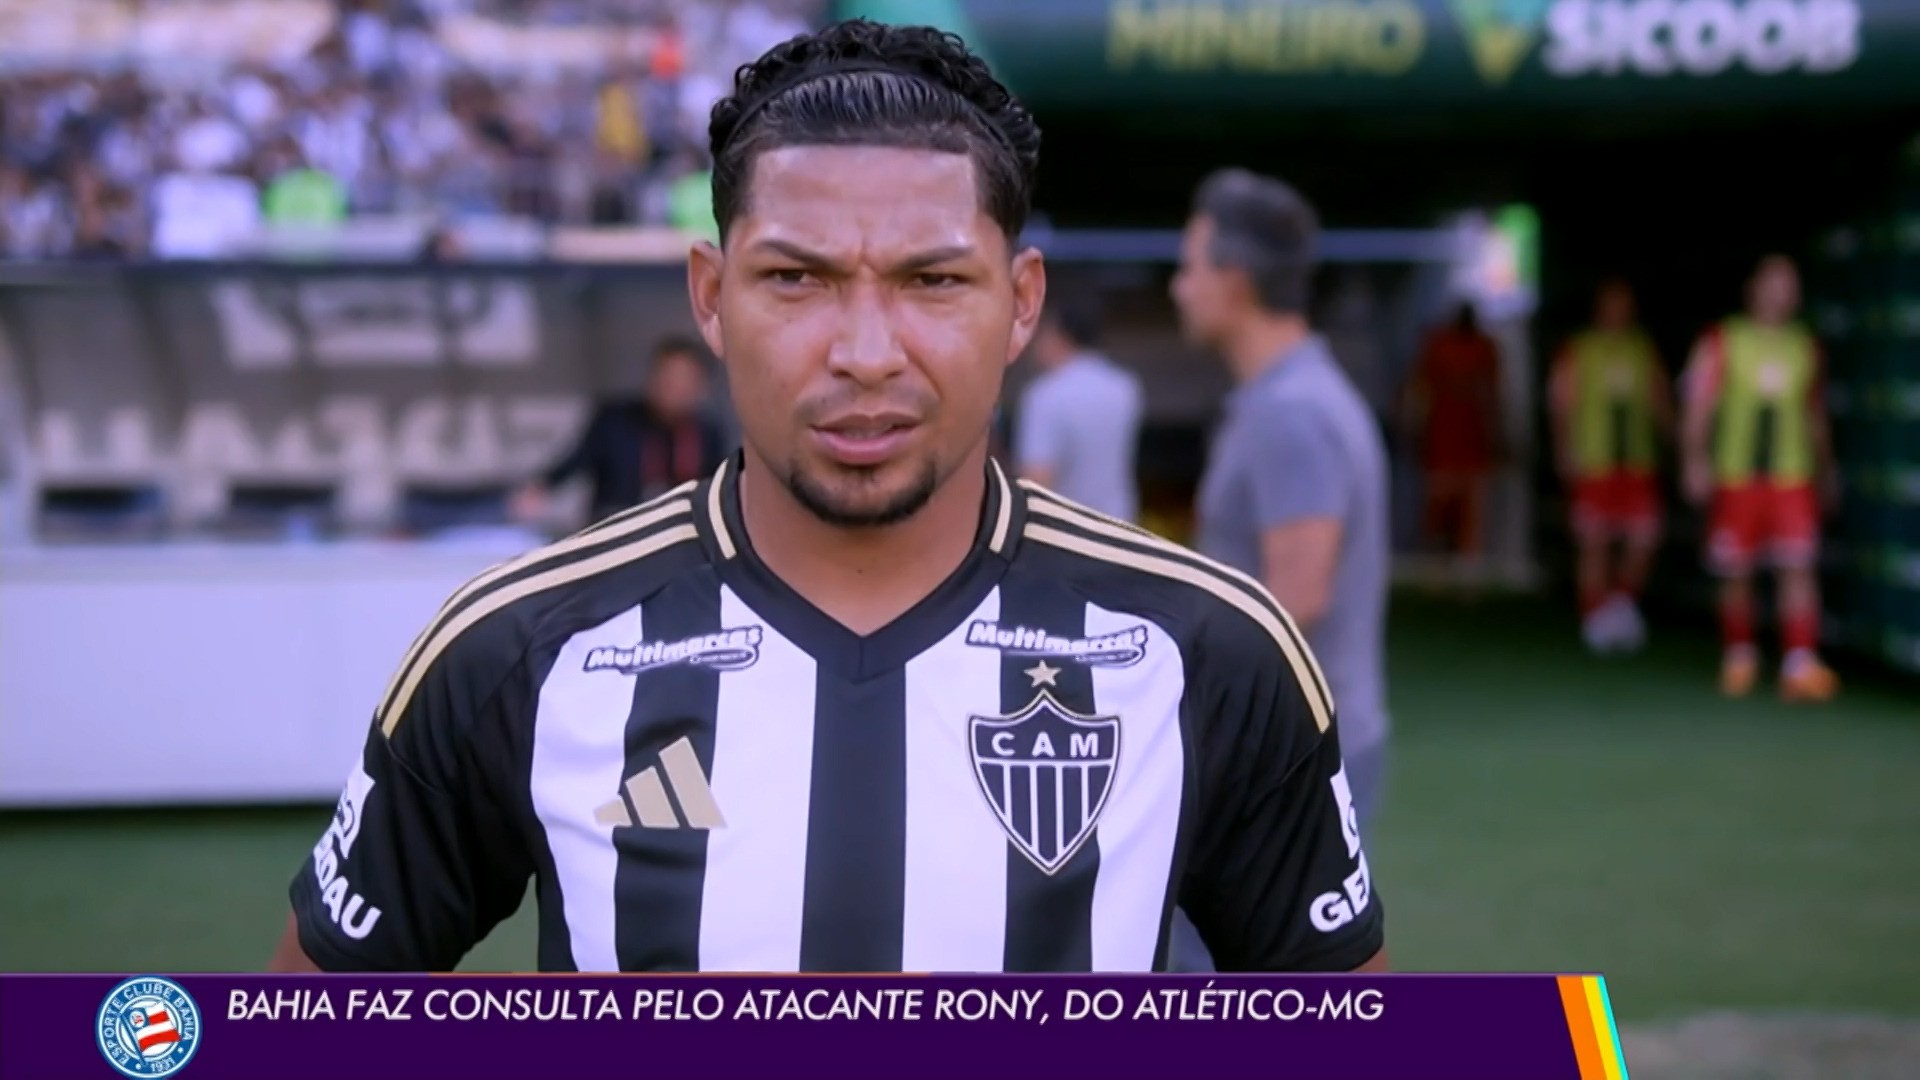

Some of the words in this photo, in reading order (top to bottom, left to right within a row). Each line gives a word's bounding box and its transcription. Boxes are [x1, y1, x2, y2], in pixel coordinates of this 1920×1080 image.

[1542, 0, 1860, 74] SICOOB
[586, 627, 762, 669] Multimarcas
[968, 621, 1147, 654] Multimarcas
[991, 731, 1099, 758] CAM
